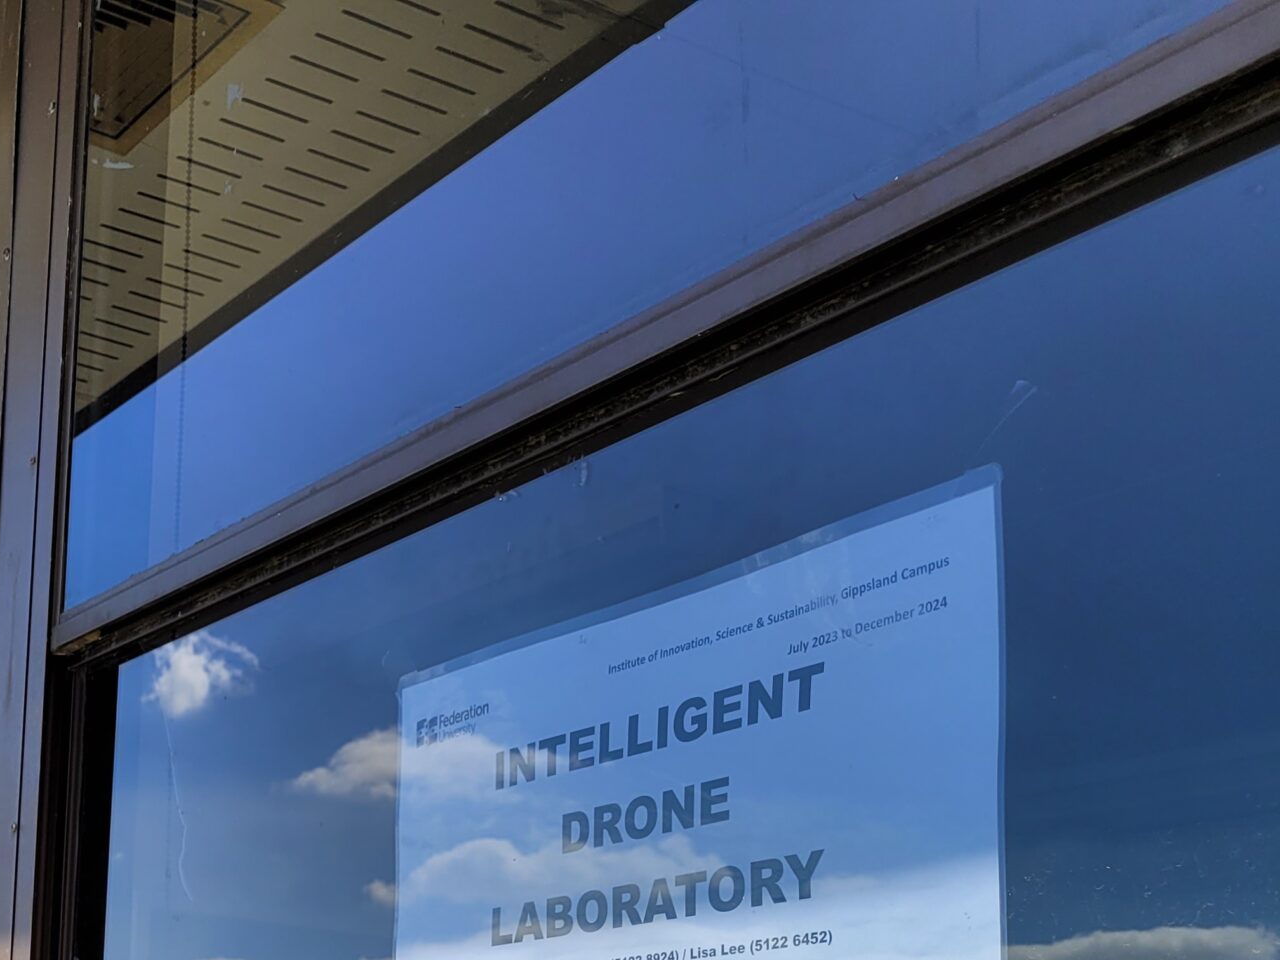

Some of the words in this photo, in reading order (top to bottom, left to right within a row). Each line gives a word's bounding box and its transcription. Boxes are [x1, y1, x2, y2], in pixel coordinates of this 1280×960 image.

[608, 656, 646, 675] Institute
[648, 650, 658, 663] of
[660, 635, 713, 659] Innovation,
[715, 622, 753, 641] Science
[756, 617, 765, 629] &
[767, 593, 838, 625] Sustainability,
[841, 570, 898, 600] Gippsland
[901, 556, 950, 580] Campus
[787, 640, 809, 655] July
[812, 630, 838, 648] 2023
[841, 628, 852, 639] to
[855, 607, 915, 634] December
[918, 596, 948, 616] 2024
[439, 702, 489, 729] Federation
[495, 662, 824, 790] INTELLIGENT
[561, 776, 730, 854] DRONE
[490, 849, 825, 946] LABORATORY
[690, 947, 716, 960] Lisa
[721, 943, 745, 956] Lee
[750, 936, 788, 956] (5122
[793, 930, 833, 947] 6452)
